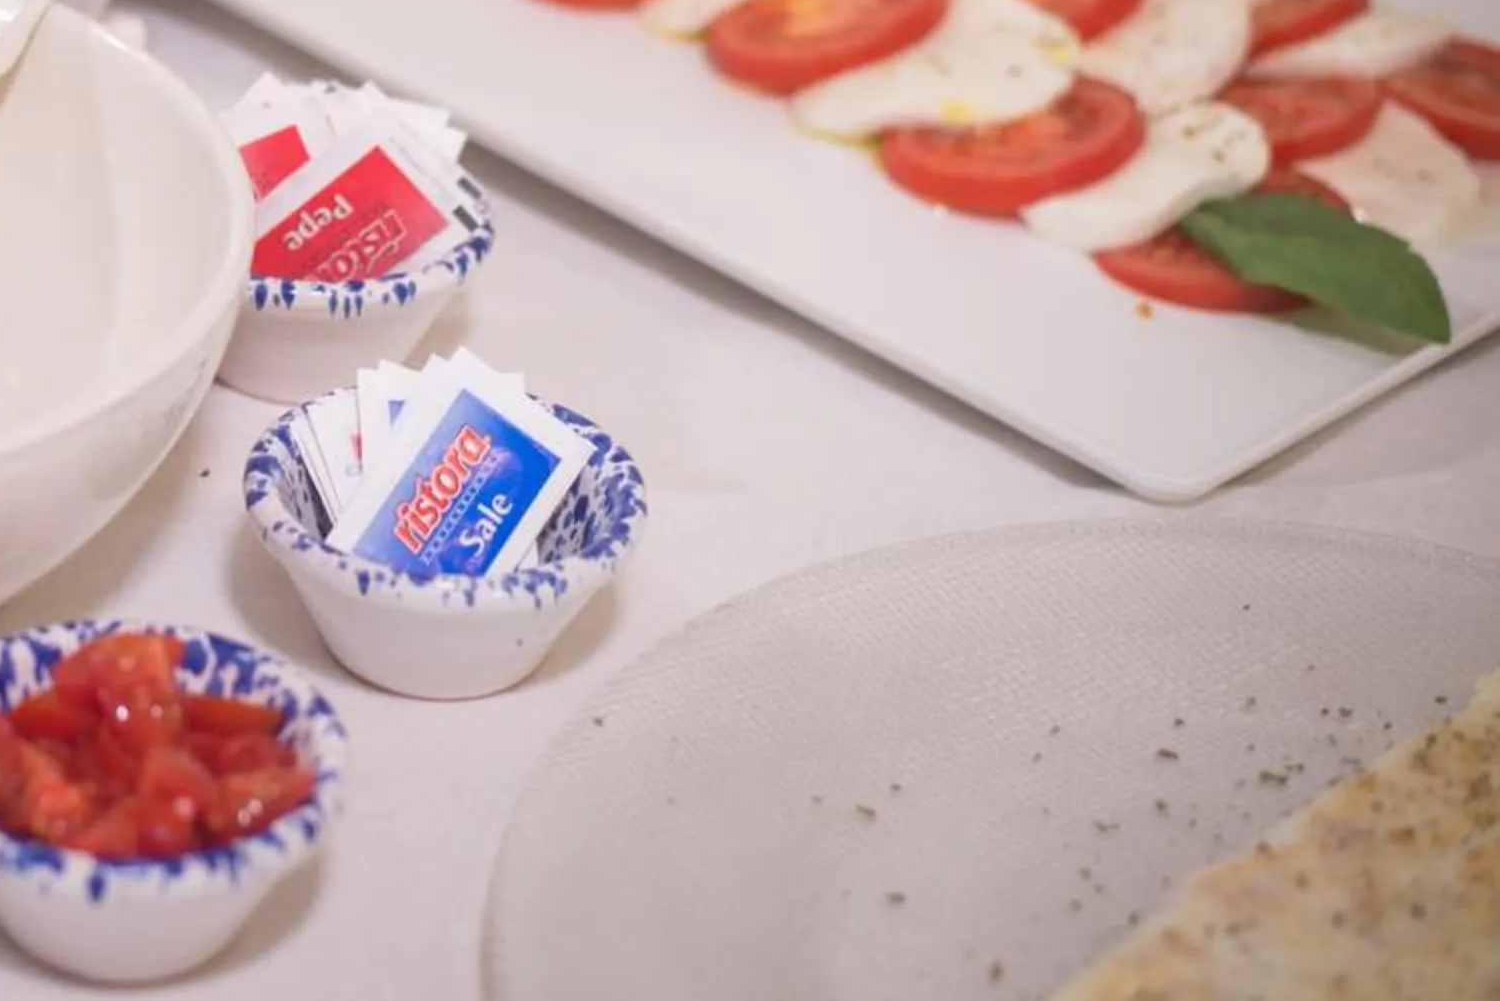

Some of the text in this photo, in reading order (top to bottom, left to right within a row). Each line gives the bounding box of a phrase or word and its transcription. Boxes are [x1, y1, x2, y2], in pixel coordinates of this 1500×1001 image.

[282, 194, 354, 251] Pepe
[393, 424, 492, 556] ristora
[459, 493, 513, 557] Sale
